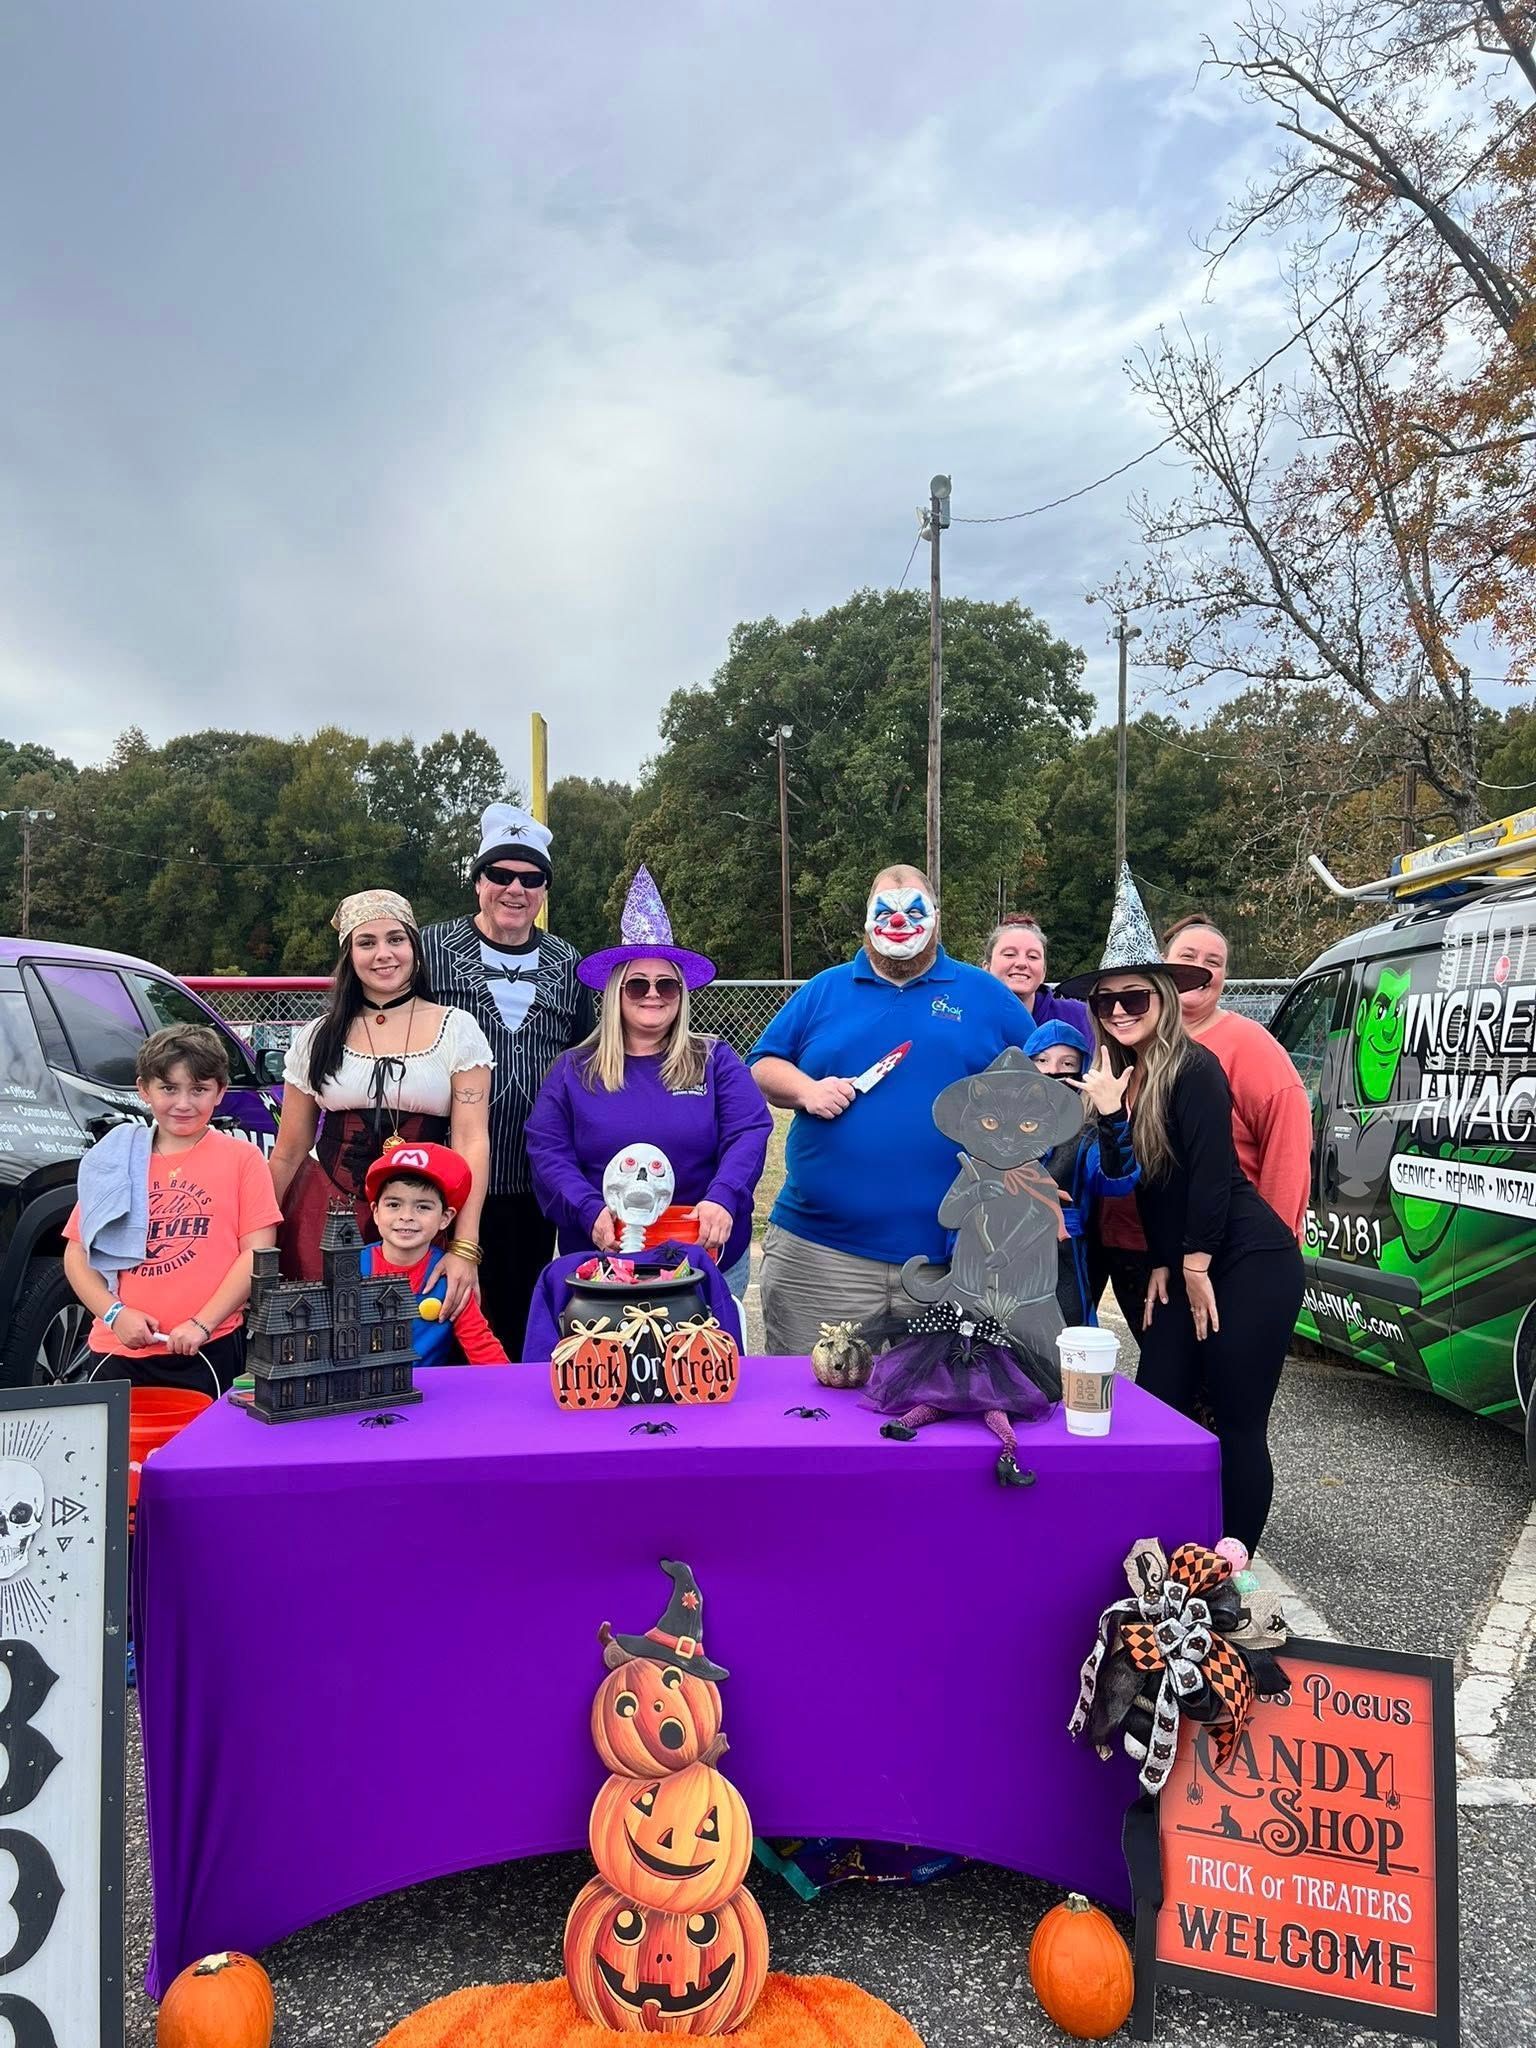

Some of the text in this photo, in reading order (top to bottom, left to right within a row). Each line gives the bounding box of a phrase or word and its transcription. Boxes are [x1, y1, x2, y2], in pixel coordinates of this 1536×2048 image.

[1403, 985, 1536, 1053] INCRE
[10, 1086, 37, 1100] Offices
[18, 1105, 51, 1118] Common
[1411, 1074, 1536, 1142] HVAC
[396, 1152, 423, 1166] M
[170, 1180, 212, 1206] BANKS
[1397, 1162, 1536, 1208] SERVICE REPAIR INSTAL
[1303, 1209, 1381, 1259] 5-2181
[141, 1249, 197, 1277] CAROLINA
[556, 1352, 736, 1391] Trick Or Treat
[1258, 1787, 1404, 1876] SHOP
[1186, 1854, 1413, 1925] TRICK or TREATERS
[1176, 1902, 1417, 1992] WELCOME
